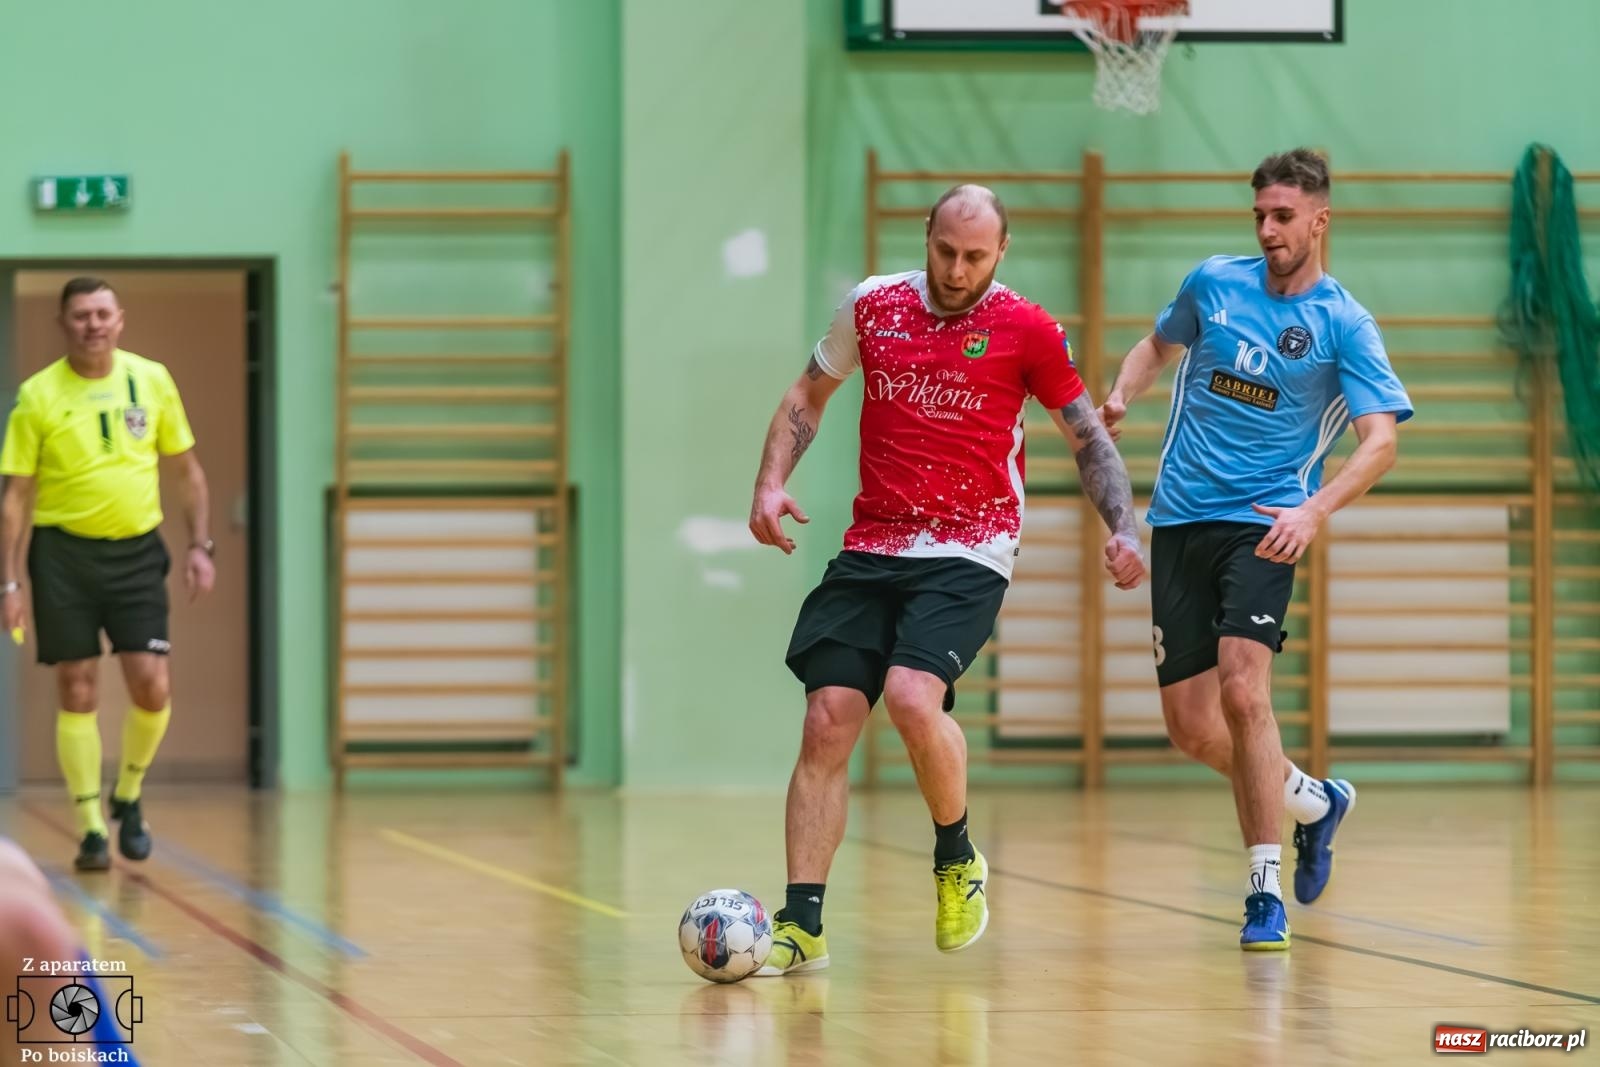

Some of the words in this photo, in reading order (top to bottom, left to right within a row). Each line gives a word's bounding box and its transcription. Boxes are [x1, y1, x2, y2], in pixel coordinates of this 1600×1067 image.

[1234, 339, 1269, 376] 10
[936, 369, 969, 384] Willa
[1214, 374, 1276, 402] GABRIEL
[867, 370, 989, 411] Wiktoria
[916, 404, 964, 422] Brenna
[695, 897, 744, 911] SELECT
